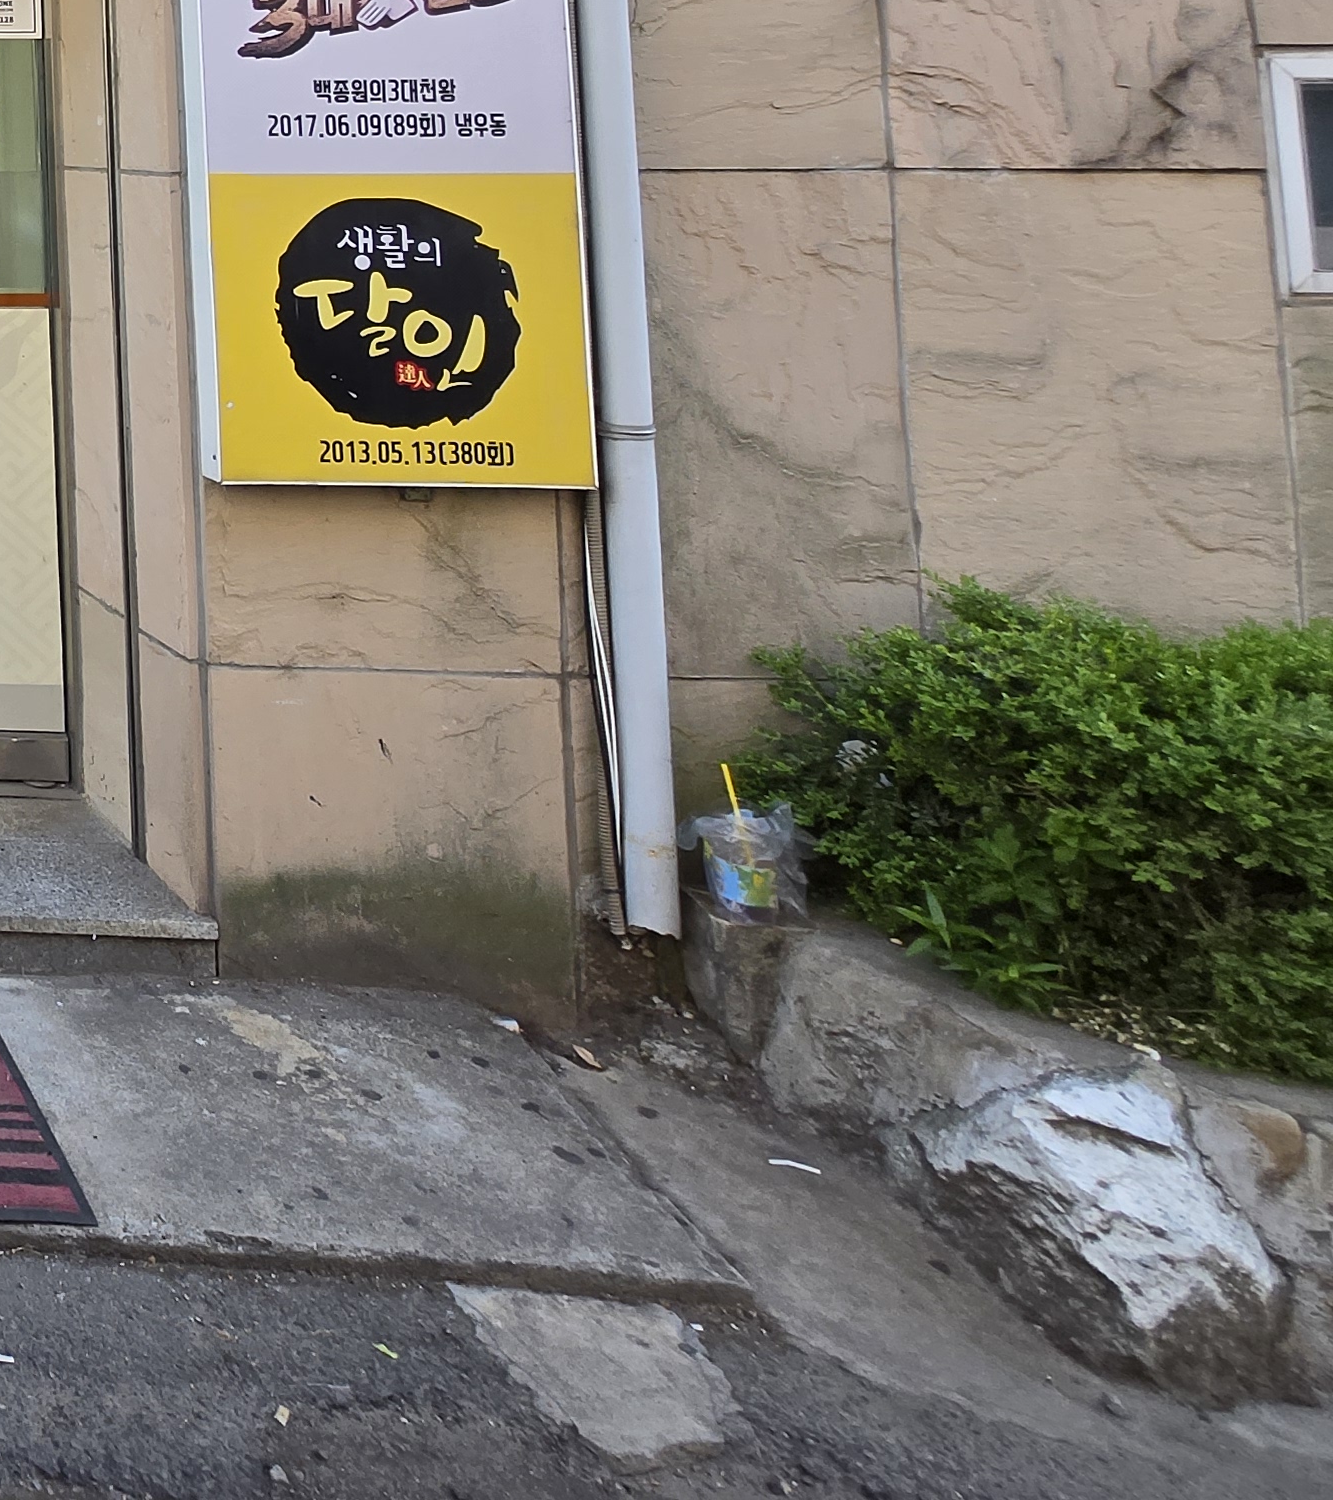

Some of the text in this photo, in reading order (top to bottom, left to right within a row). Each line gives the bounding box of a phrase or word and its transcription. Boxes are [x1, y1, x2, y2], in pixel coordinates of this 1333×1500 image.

[313, 78, 456, 104] 백종원의3대천왕
[267, 112, 507, 138] 2017.06.09(89회) 냉우동
[336, 224, 442, 271] 생활의
[292, 271, 486, 391] 달인
[319, 439, 515, 467] 2013.05.13(380회)
